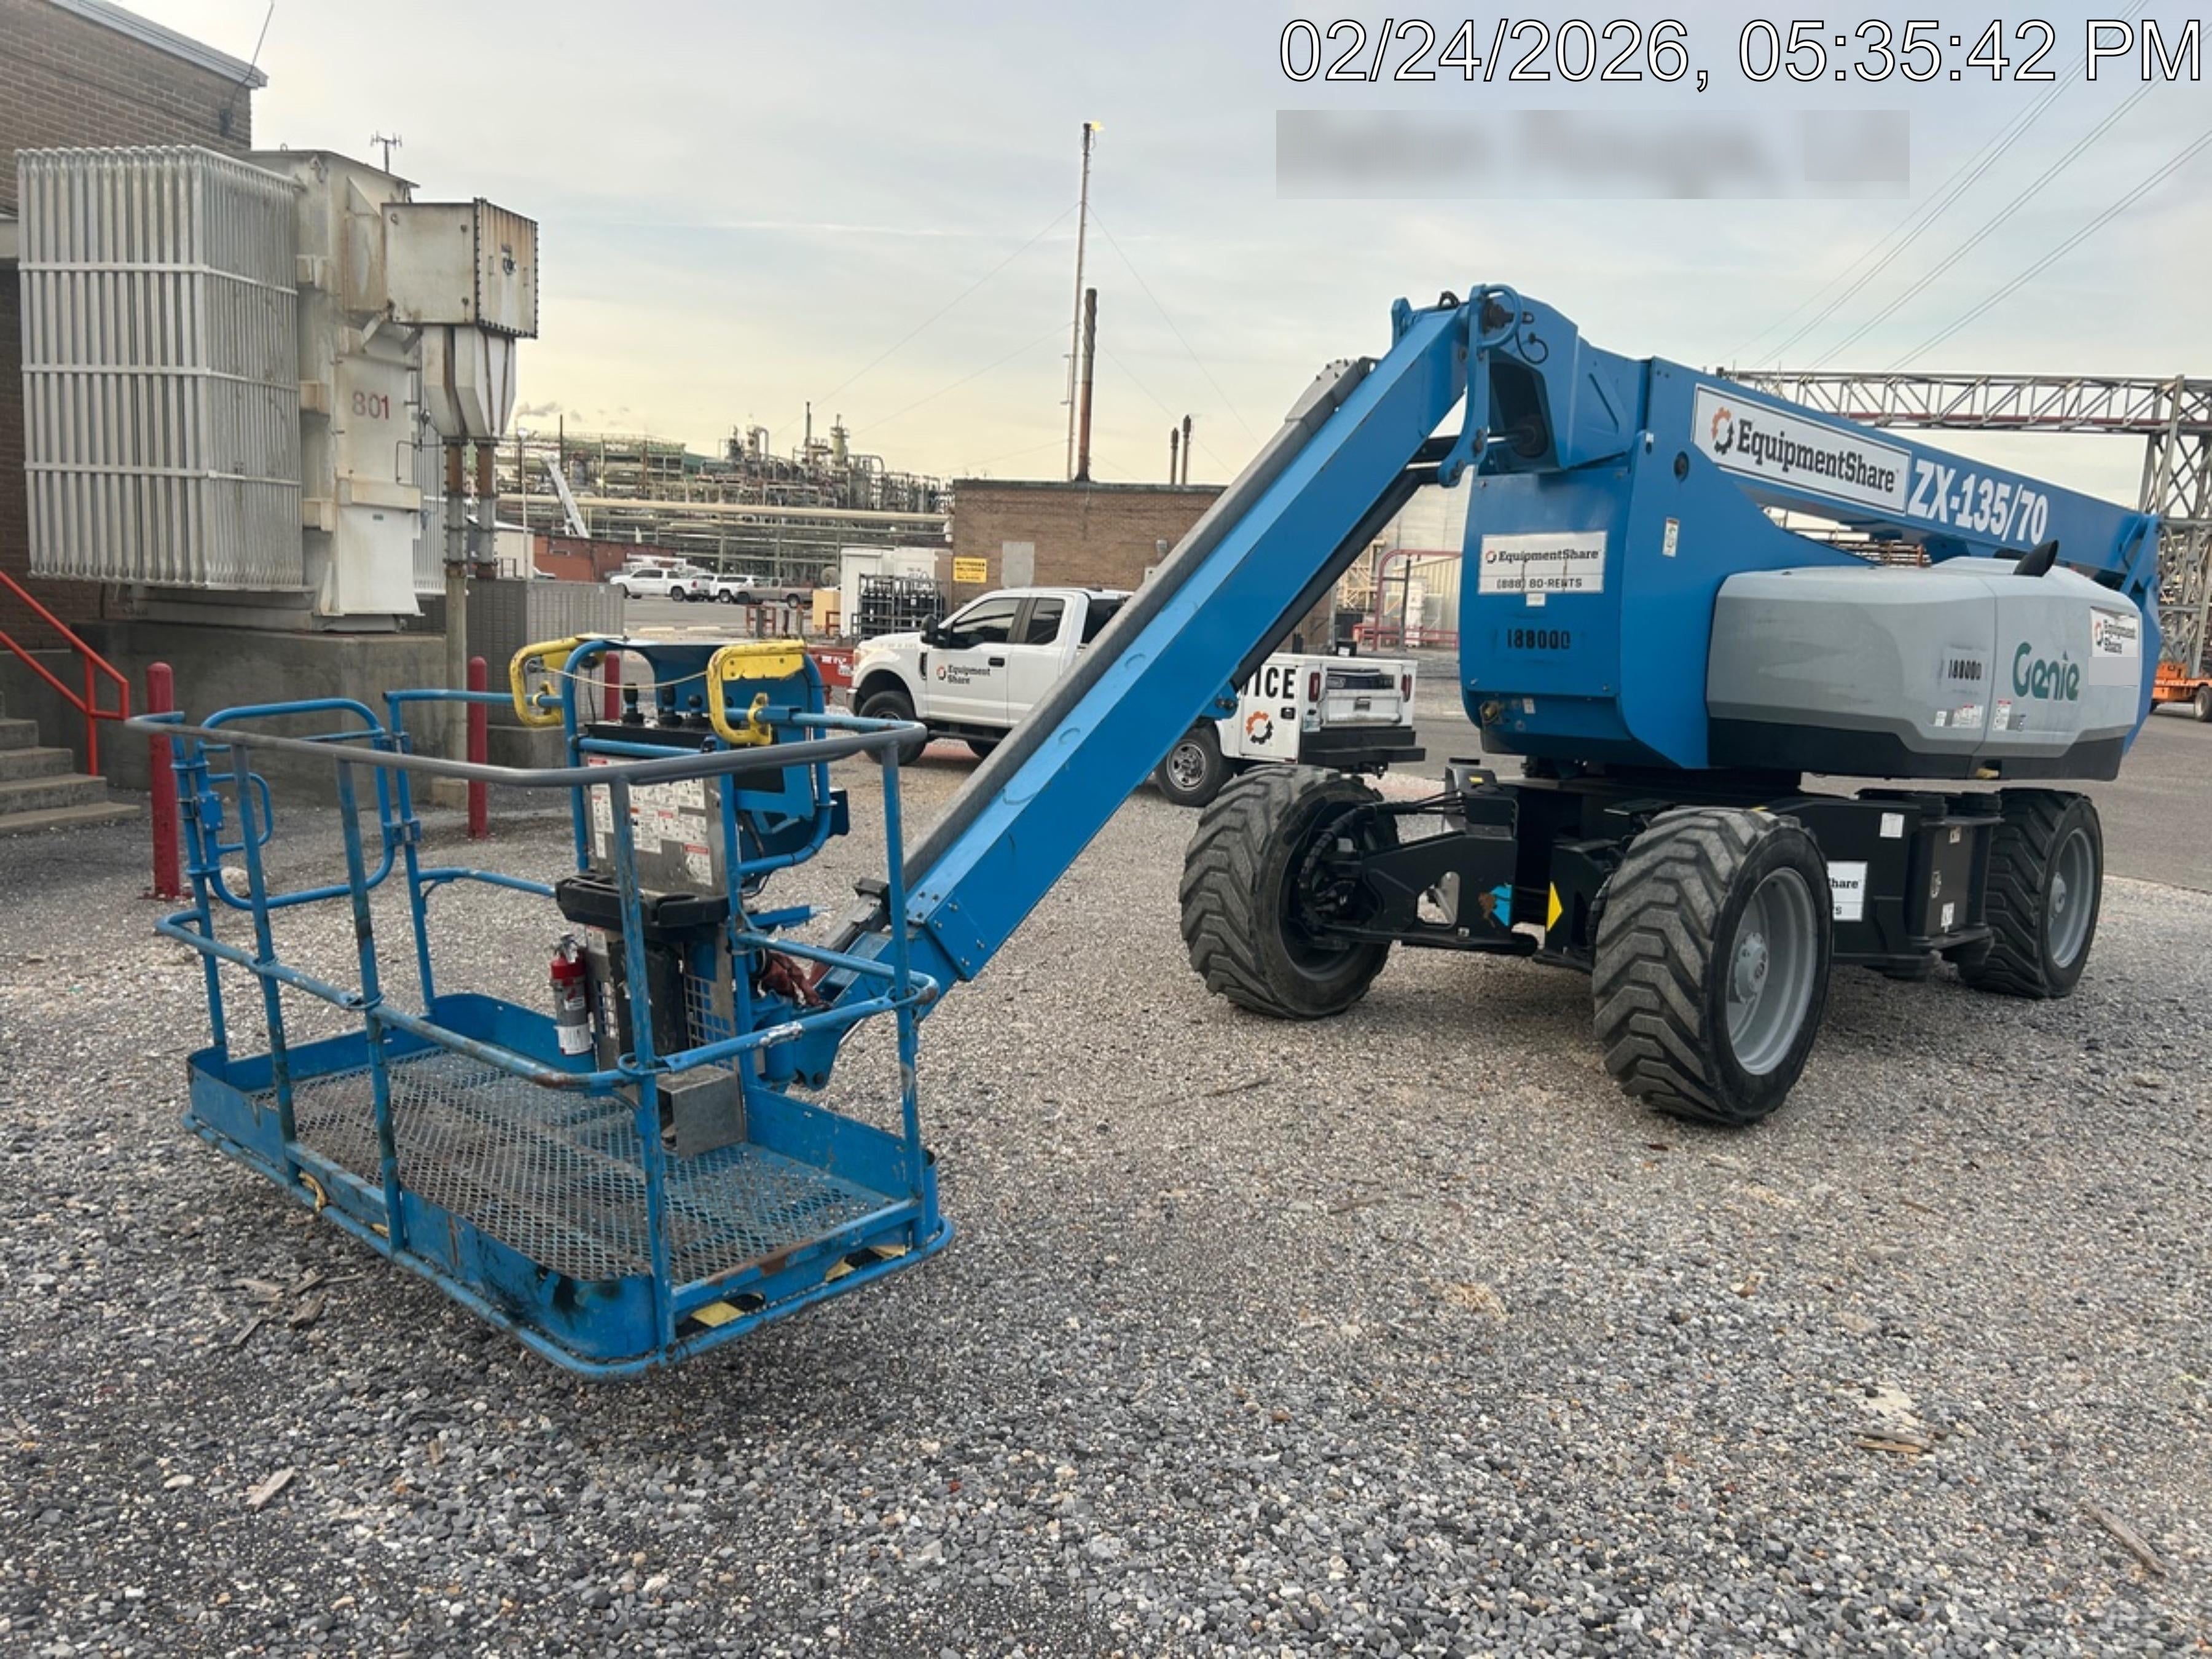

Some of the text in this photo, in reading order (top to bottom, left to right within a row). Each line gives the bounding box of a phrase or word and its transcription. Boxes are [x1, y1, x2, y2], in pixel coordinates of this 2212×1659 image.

[353, 390, 390, 420] 801
[1736, 418, 1896, 493] EquipmentShare
[1907, 458, 2049, 545] ZX-135/70
[1498, 549, 1599, 564] EquipmentShare
[1496, 578, 1526, 589] (888)
[1507, 628, 1571, 649] 188000
[2012, 641, 2080, 701] Genie
